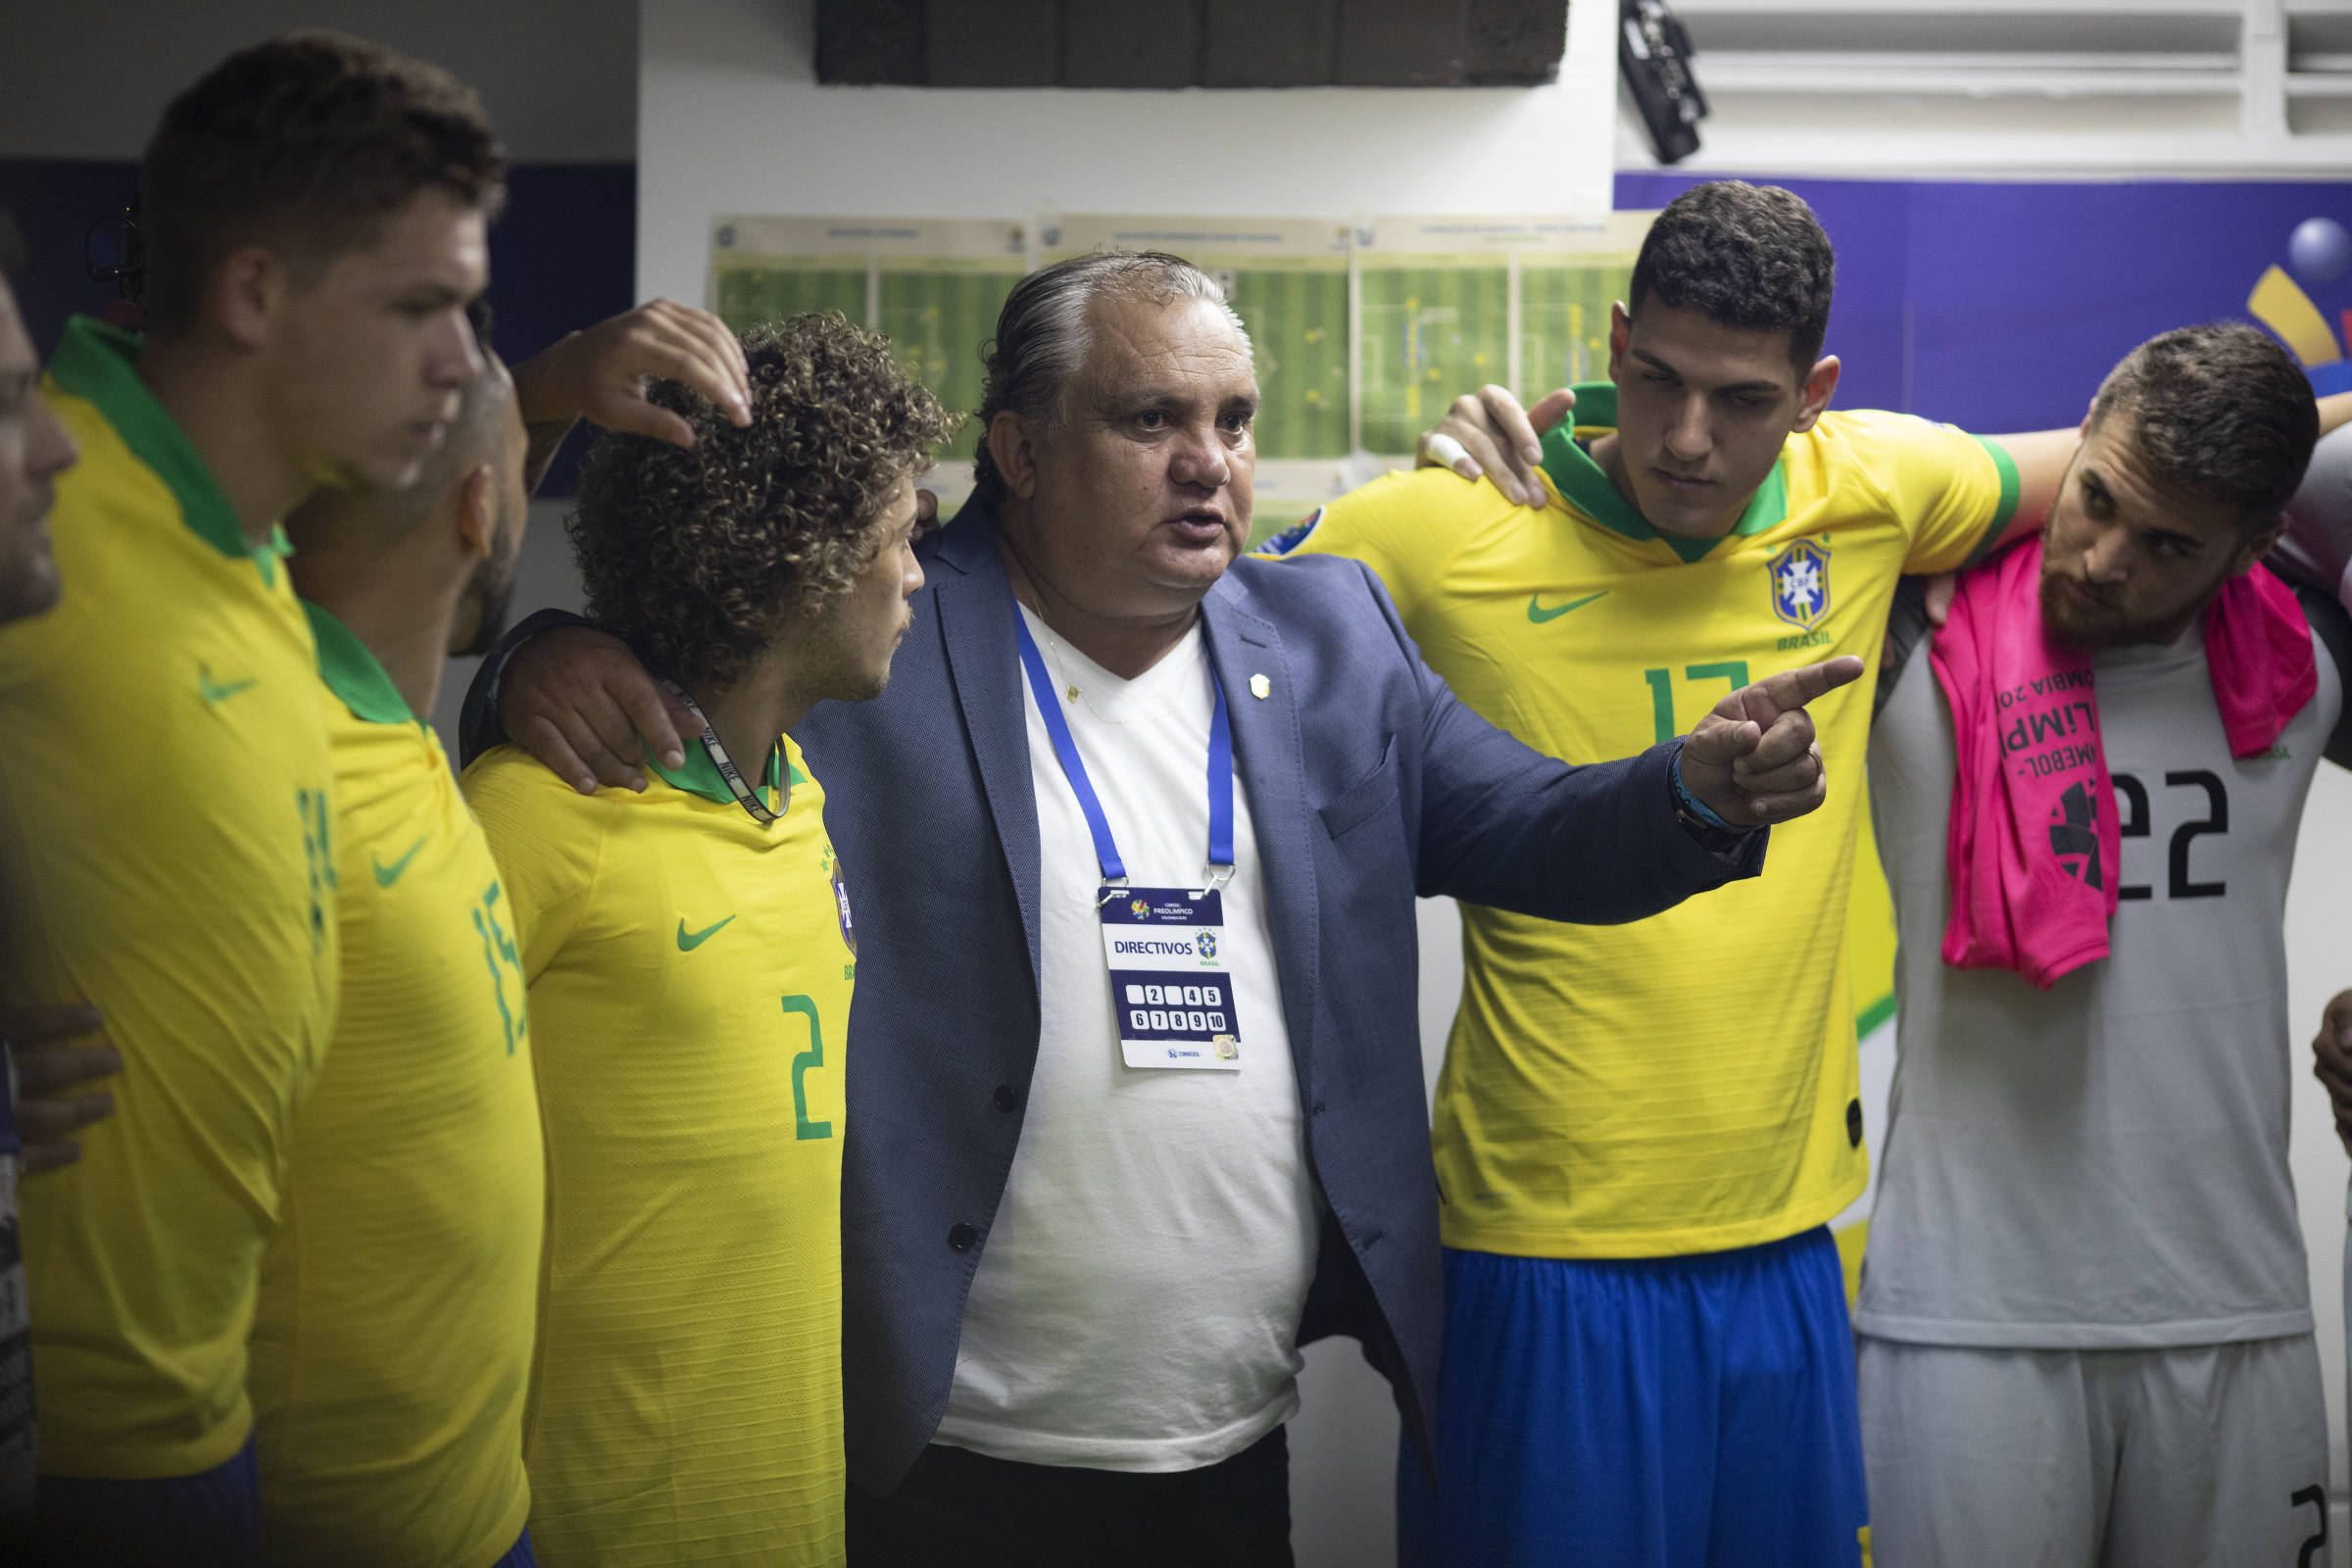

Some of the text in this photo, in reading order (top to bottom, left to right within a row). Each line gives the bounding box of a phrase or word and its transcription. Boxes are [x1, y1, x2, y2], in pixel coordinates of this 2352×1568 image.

[1777, 631, 1835, 652] BRASIL
[718, 760, 741, 783] NIKE
[741, 795, 763, 813] NIKE
[2111, 768, 2230, 901] 22
[1114, 940, 1193, 956] DIRECTIVOS
[1151, 988, 1216, 1003] 2 4 5
[1136, 1012, 1224, 1028] 6 7 8 9 10
[781, 994, 833, 1141] 2
